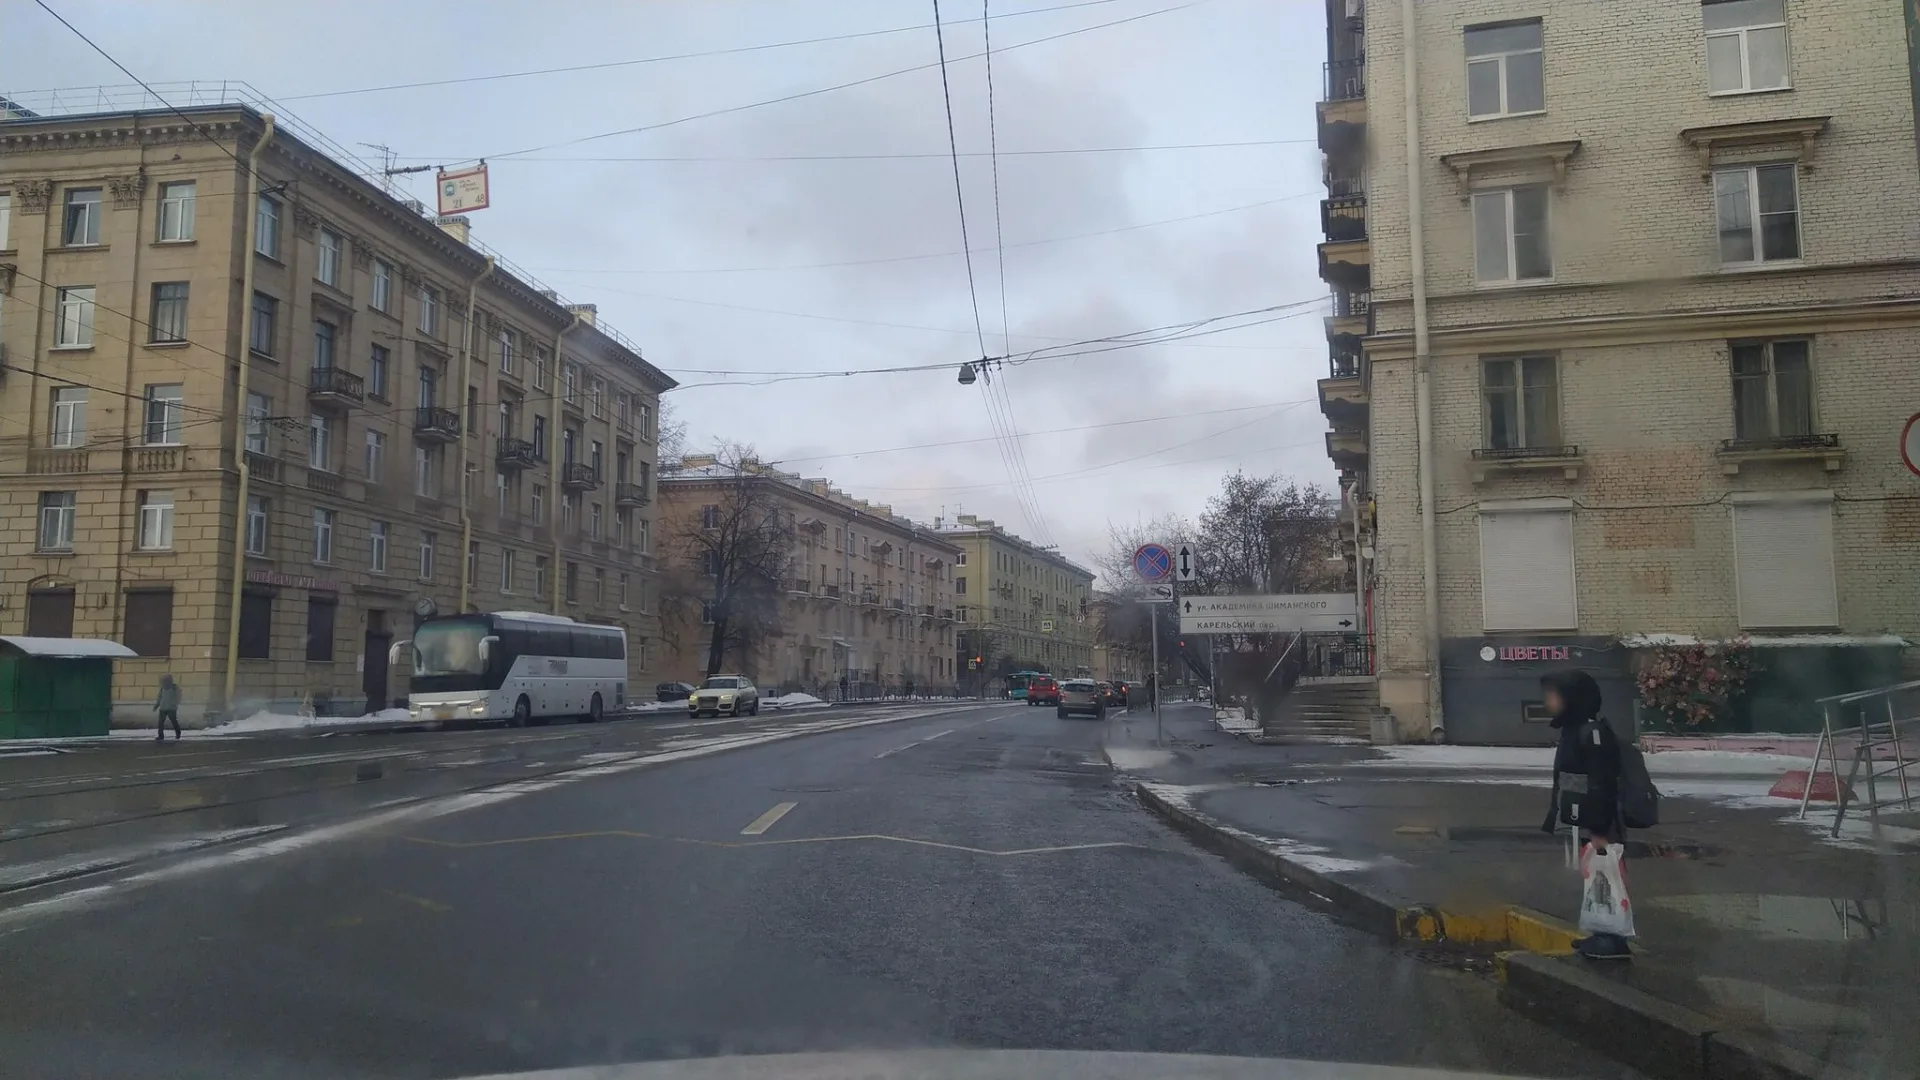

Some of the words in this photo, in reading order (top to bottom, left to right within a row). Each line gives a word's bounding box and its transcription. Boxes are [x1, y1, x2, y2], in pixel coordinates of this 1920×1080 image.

[1196, 604, 1208, 612] ул.
[1265, 601, 1327, 610] ШИМАНСКОГО
[1197, 620, 1256, 629] КАРЕЛЬСКИЙ
[1499, 646, 1569, 661] ЦВЕТЫ
